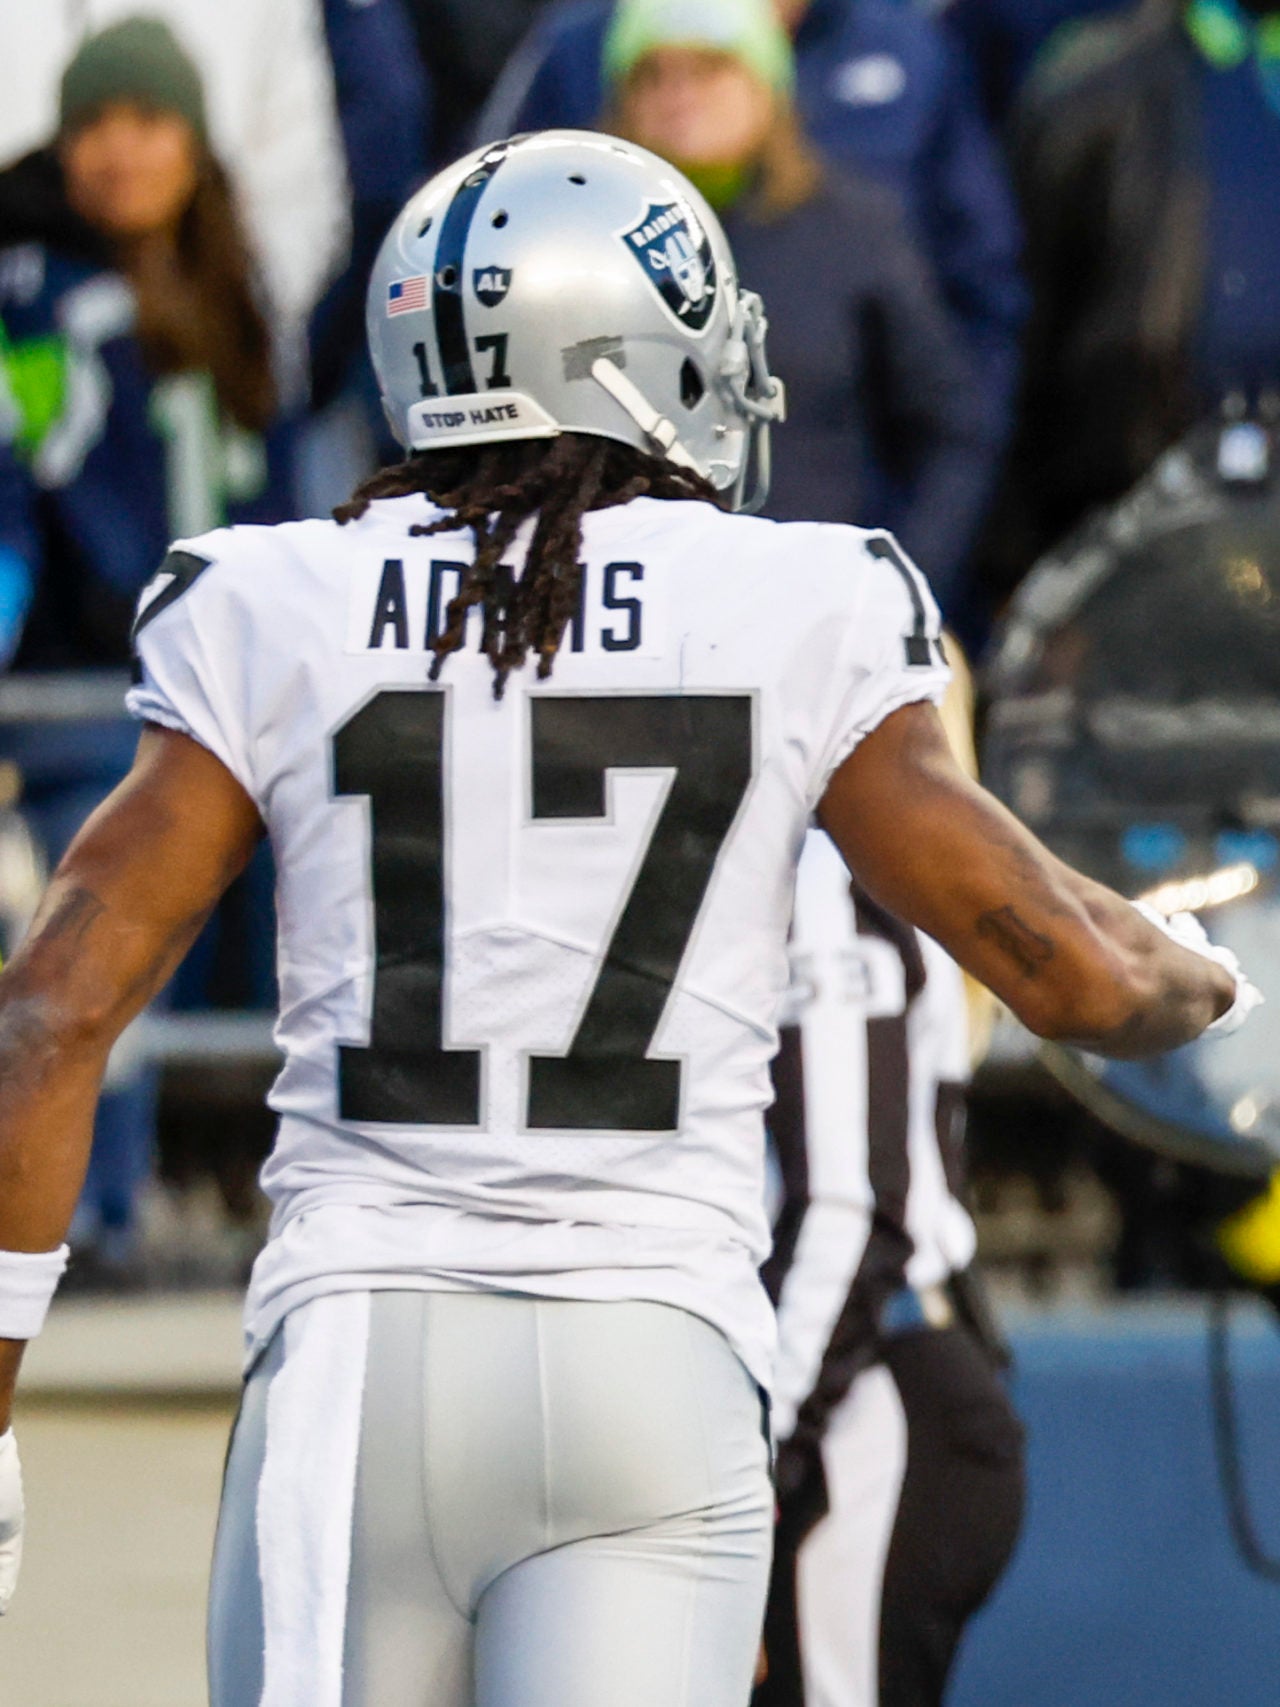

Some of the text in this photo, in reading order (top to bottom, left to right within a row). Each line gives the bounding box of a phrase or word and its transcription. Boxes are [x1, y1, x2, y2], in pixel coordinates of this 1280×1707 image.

[630, 203, 694, 248] RAIDER
[477, 273, 507, 291] AL
[422, 404, 518, 428] STOP HATE
[329, 684, 760, 1135] 17
